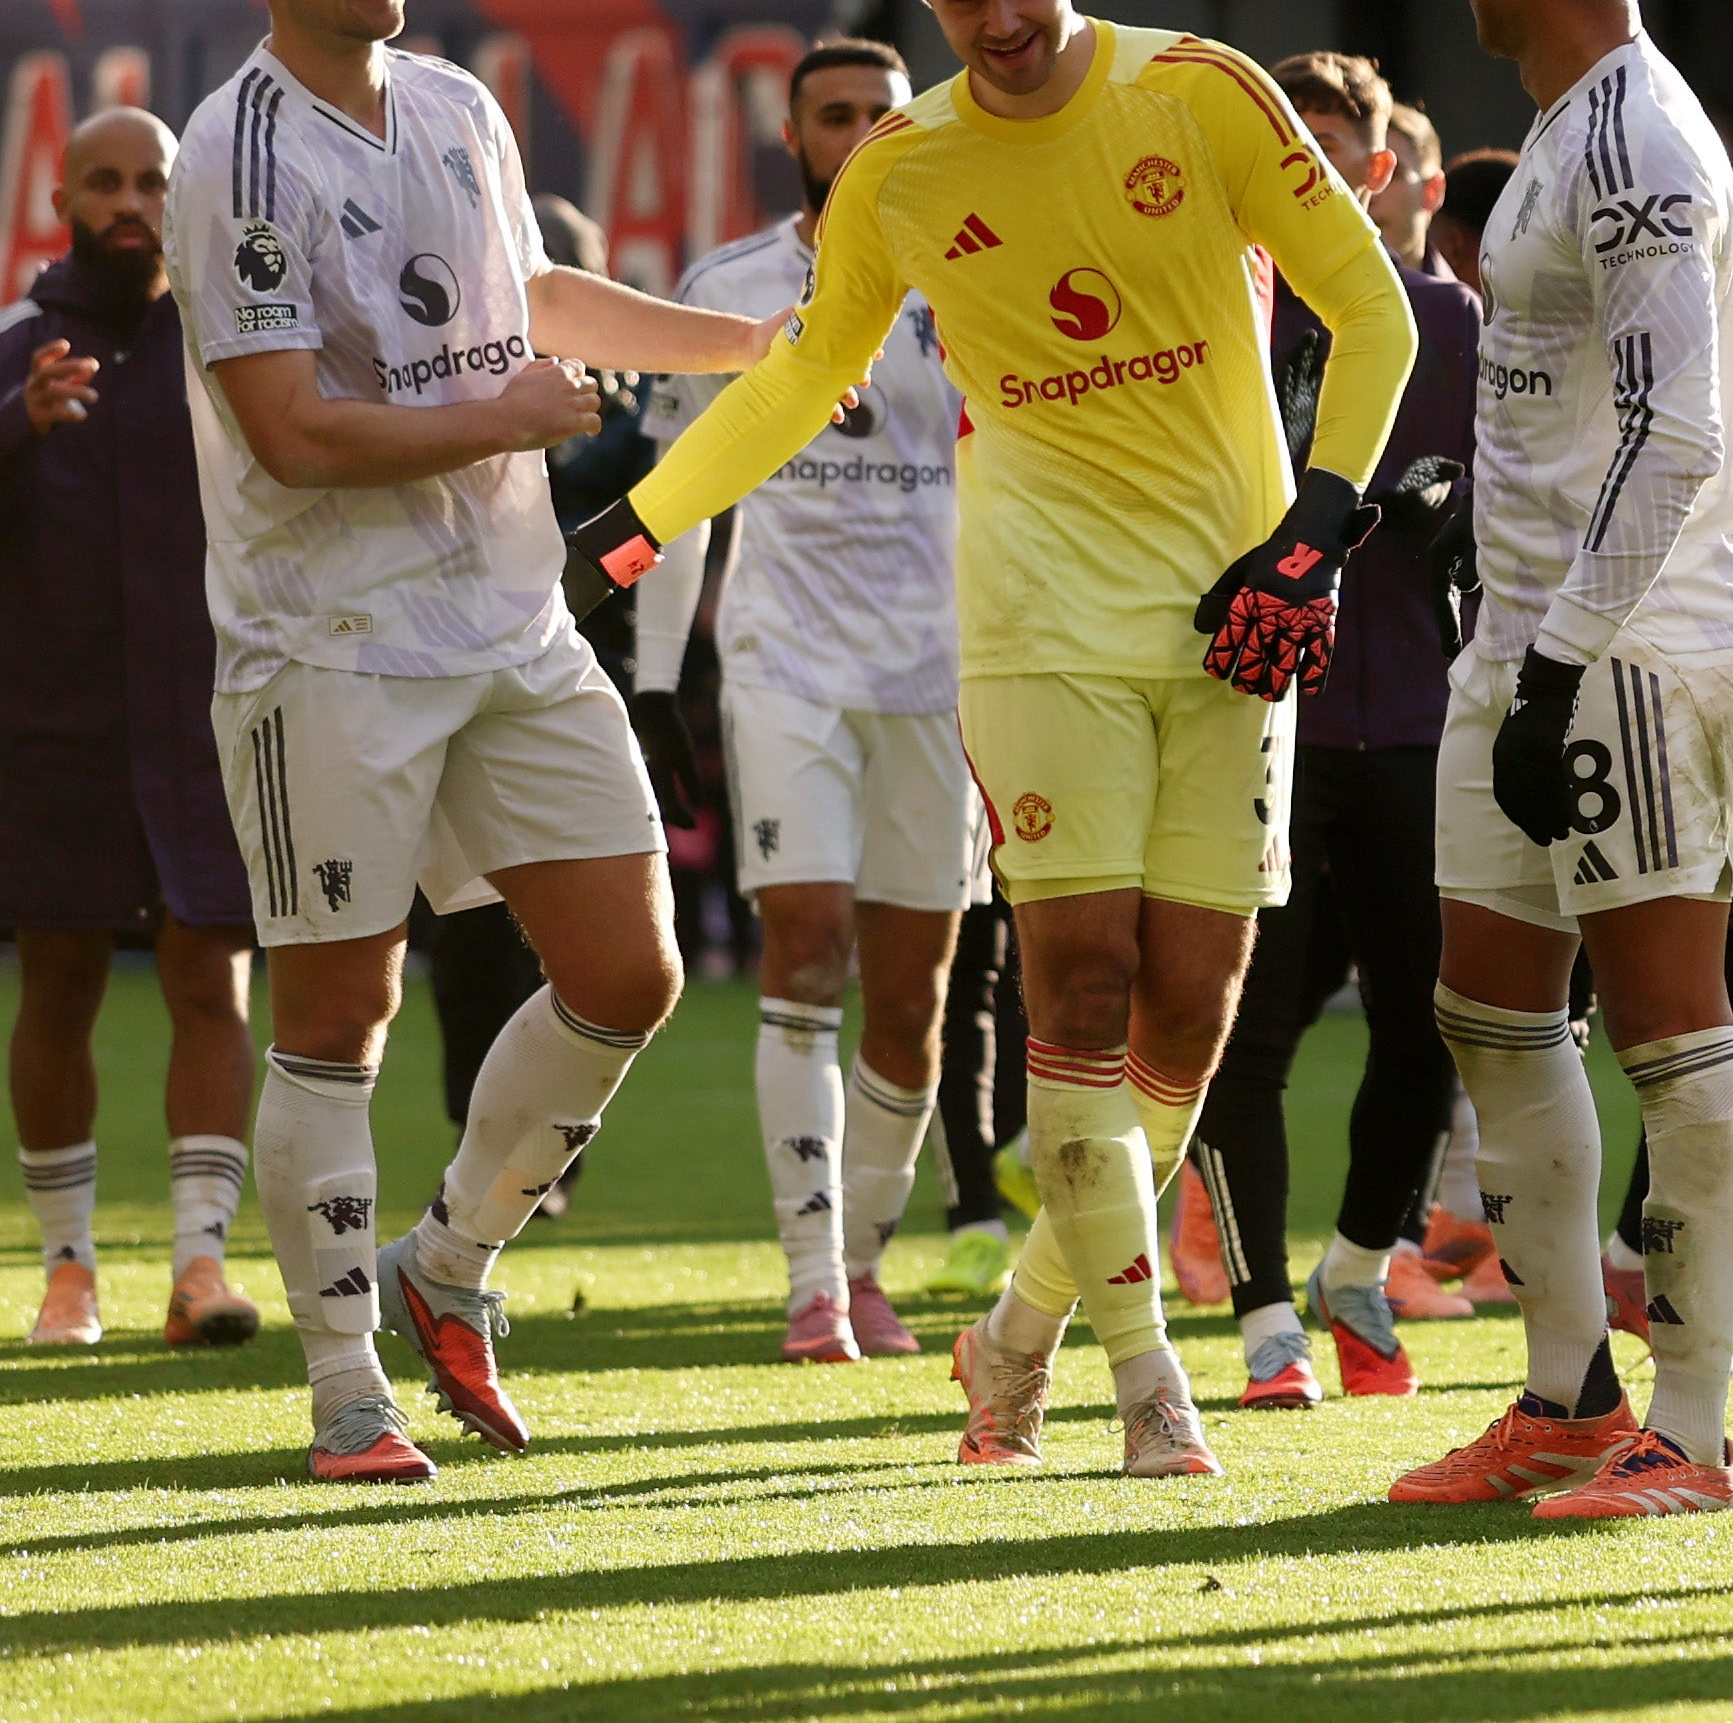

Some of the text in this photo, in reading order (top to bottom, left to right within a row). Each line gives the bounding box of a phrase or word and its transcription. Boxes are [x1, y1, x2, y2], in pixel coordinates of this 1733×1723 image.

[1599, 243, 1695, 271] TECHNOLOGY
[234, 306, 292, 321] No room
[257, 318, 300, 330] racism
[372, 335, 526, 395] Snapdrago
[1000, 340, 1213, 408] Snapdragon
[774, 455, 951, 493] napdragon
